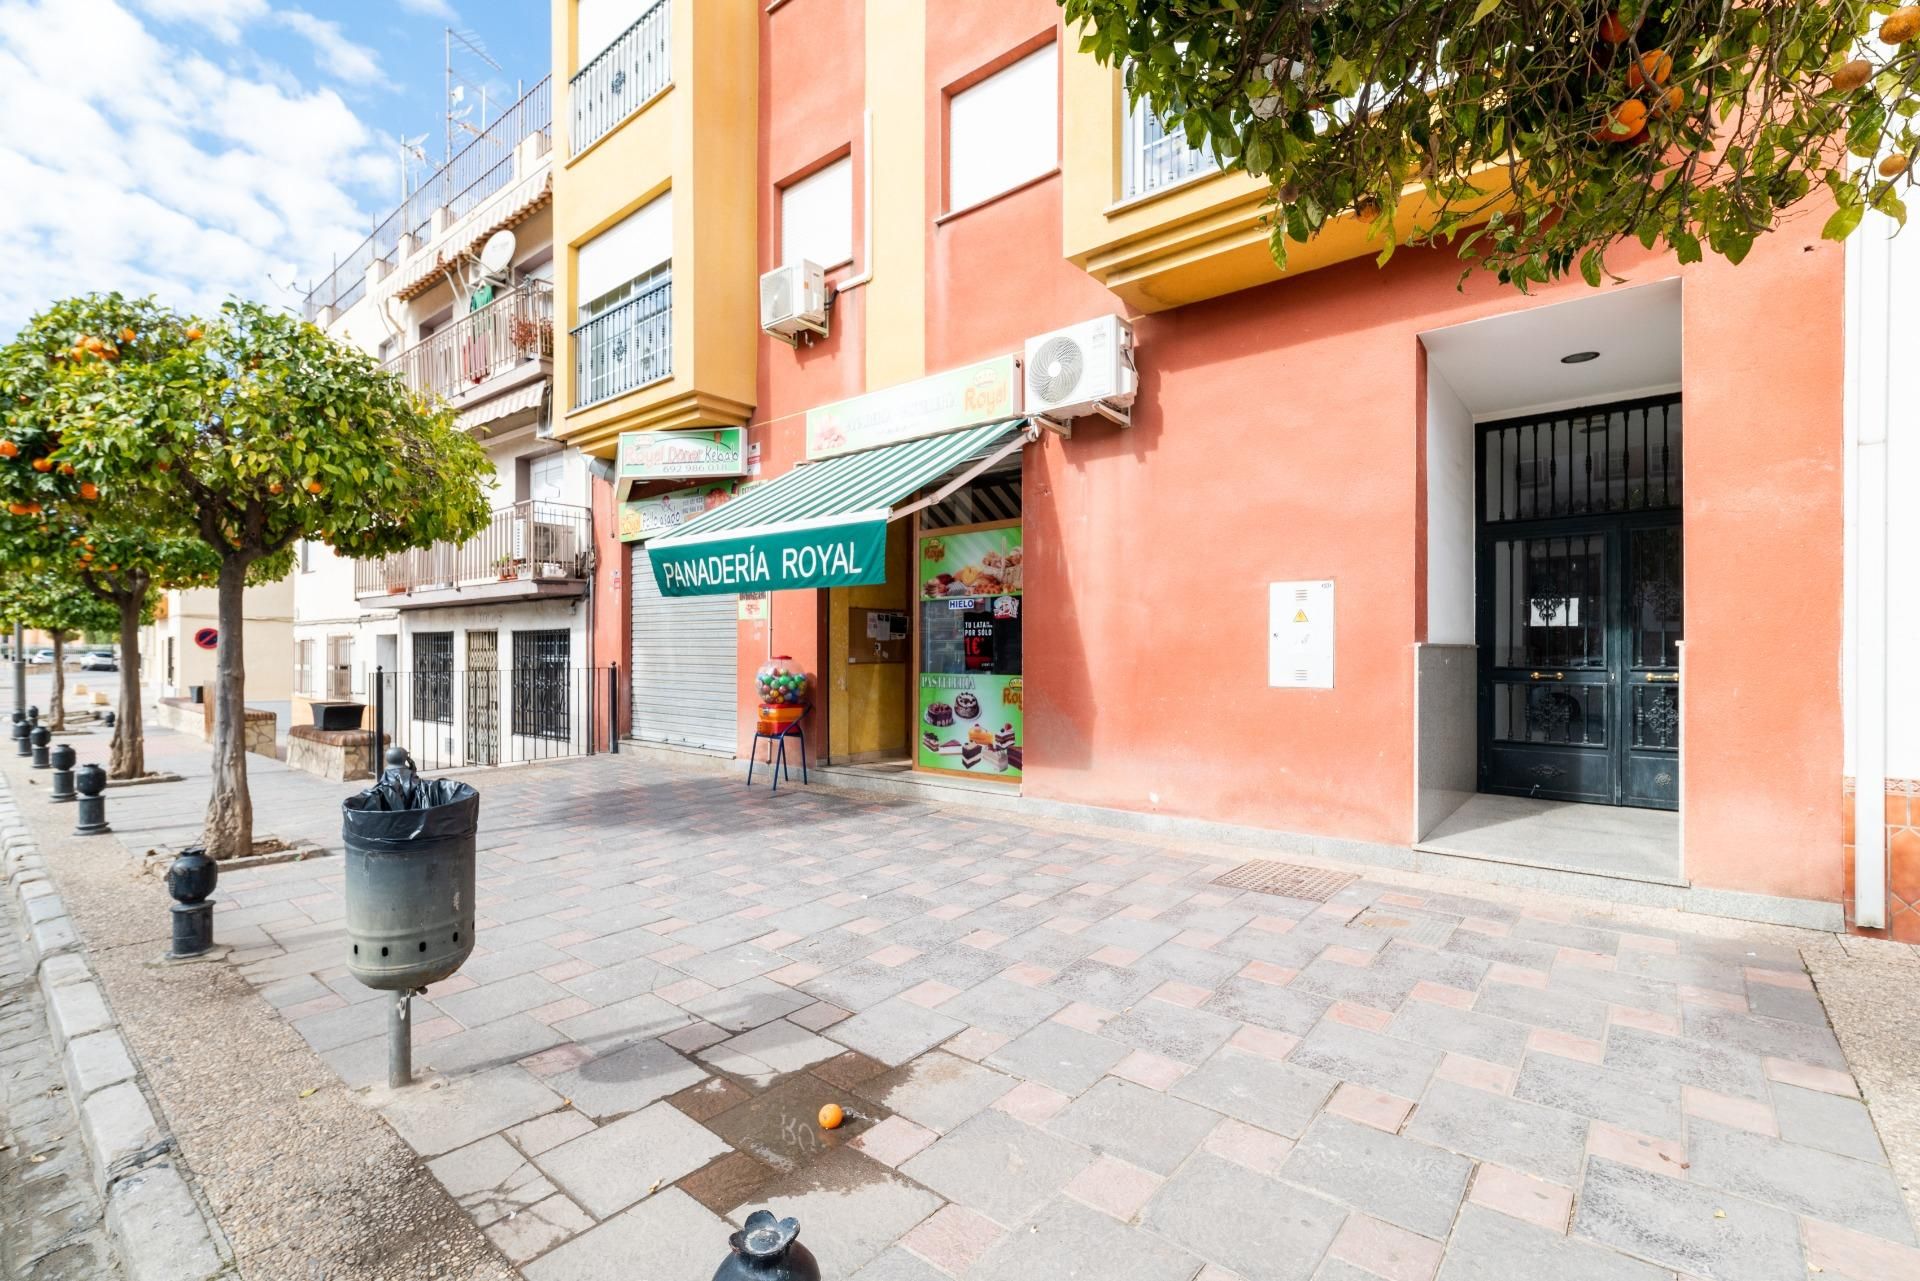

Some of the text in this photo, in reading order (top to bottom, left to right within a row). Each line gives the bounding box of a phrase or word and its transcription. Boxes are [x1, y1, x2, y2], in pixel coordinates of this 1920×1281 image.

[963, 384, 1008, 415] Royal
[704, 443, 739, 462] Kebab
[663, 541, 863, 588] PANADERÍA ROYAL
[949, 599, 974, 609] HIELO
[965, 621, 972, 629] TU
[973, 621, 986, 629] LATA
[965, 629, 976, 637] POR
